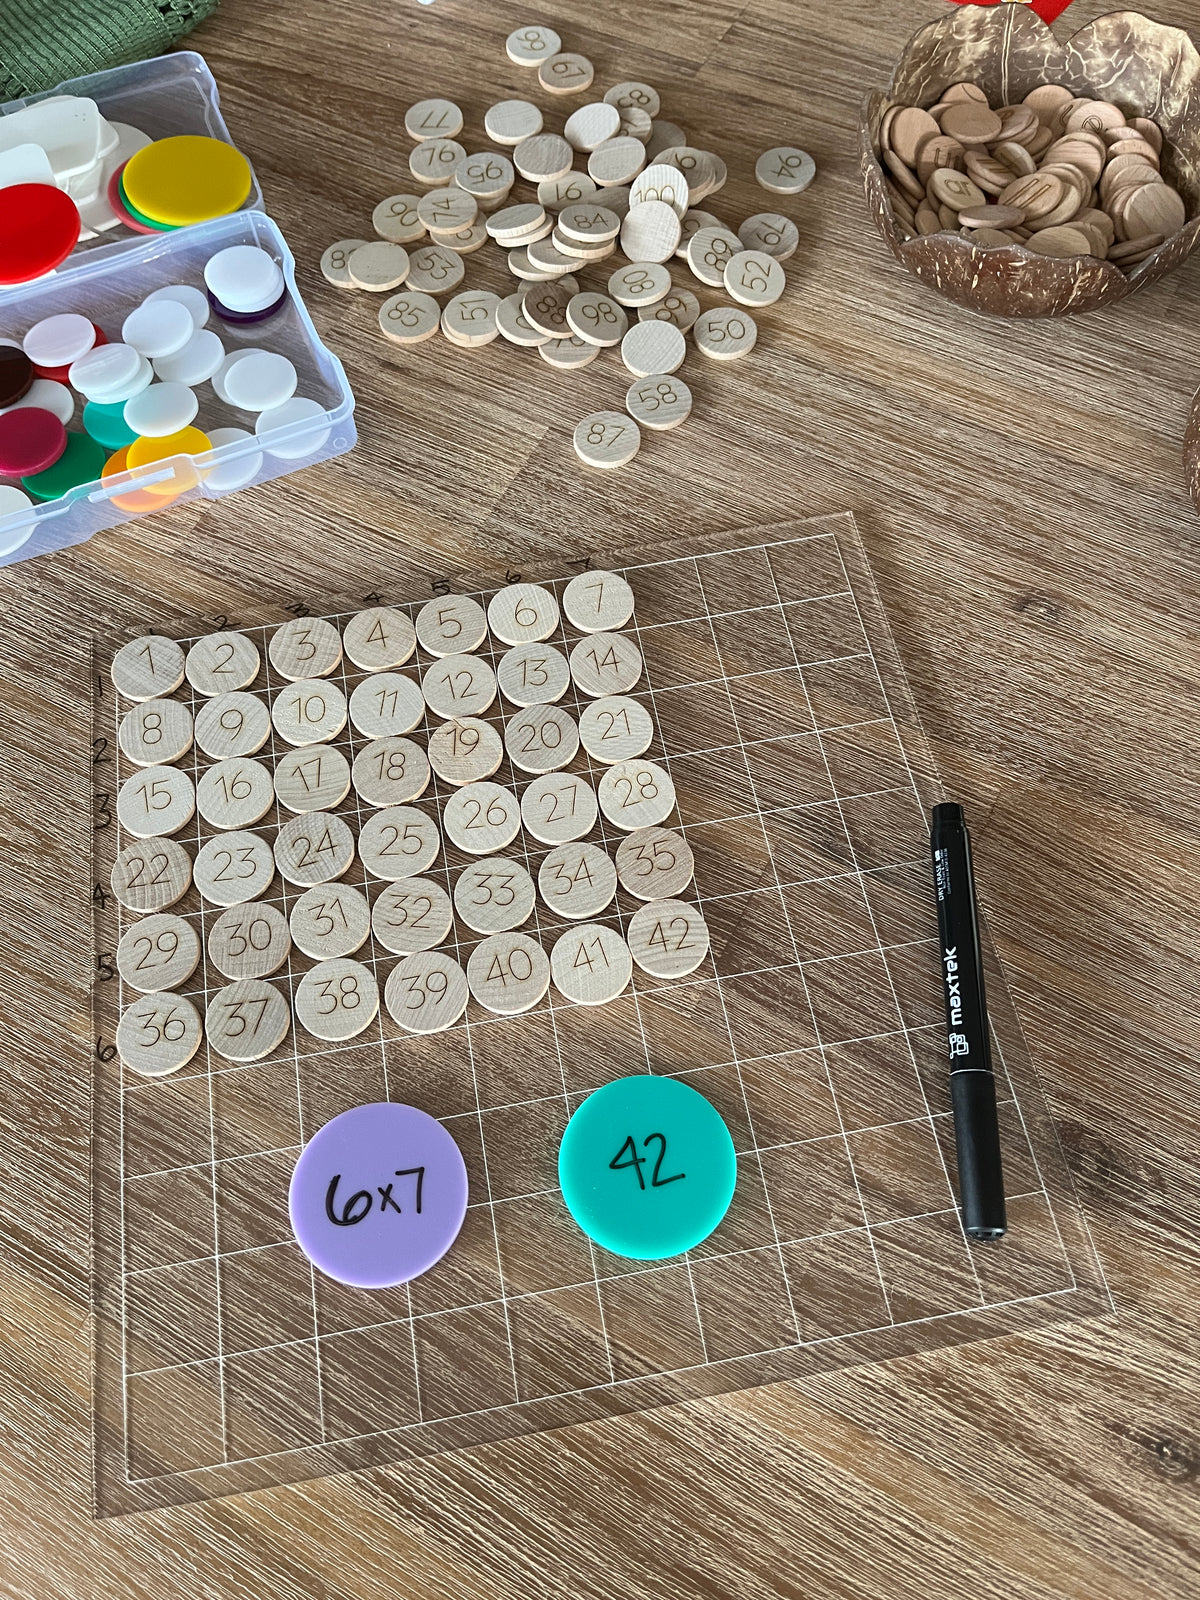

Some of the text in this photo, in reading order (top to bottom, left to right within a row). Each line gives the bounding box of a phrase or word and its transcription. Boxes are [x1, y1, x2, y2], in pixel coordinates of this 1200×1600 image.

[419, 111, 450, 129] 77
[421, 145, 456, 167] 76
[432, 198, 460, 223] 74
[574, 213, 609, 230] 84
[417, 252, 456, 280] 53
[741, 260, 771, 293] 52
[388, 301, 426, 327] 85
[459, 299, 488, 321] 51
[582, 302, 617, 327] 98
[708, 319, 745, 342] 50
[638, 383, 677, 411] 58
[587, 422, 625, 448] 87
[430, 579, 450, 597] 5
[505, 569, 522, 584] 6
[514, 598, 538, 627] 6
[585, 583, 604, 613] 7
[366, 619, 389, 648] 4
[438, 608, 462, 639] 5
[139, 644, 155, 675] 1
[211, 643, 236, 674] 2
[292, 630, 317, 661] 3
[586, 646, 621, 675] 14
[441, 671, 479, 700] 12
[516, 659, 548, 687] 13
[290, 695, 326, 724] 10
[375, 690, 399, 717] 11
[142, 713, 163, 745] 8
[220, 709, 244, 741] 9
[517, 721, 562, 753] 20
[596, 708, 632, 740] 21
[92, 737, 111, 765] 2
[446, 727, 480, 756] 19
[291, 757, 322, 792] 17
[373, 751, 406, 781] 18
[135, 780, 172, 814] 15
[214, 770, 252, 803] 16
[614, 771, 659, 808] 28
[94, 793, 112, 831] 3
[462, 797, 507, 830] 26
[539, 785, 577, 823] 27
[291, 828, 338, 868] 24
[378, 824, 424, 857] 25
[126, 854, 171, 889] 22
[212, 847, 257, 882] 23
[629, 839, 676, 876] 35
[471, 872, 516, 906] 33
[548, 857, 595, 895] 34
[93, 882, 110, 910] 4
[387, 893, 432, 929] 32
[308, 898, 348, 937] 31
[224, 918, 272, 957] 30
[649, 917, 696, 952] 42
[133, 931, 179, 971] 29
[573, 936, 610, 974] 41
[96, 953, 114, 982] 5
[486, 948, 533, 987] 40
[314, 976, 361, 1015] 38
[402, 971, 448, 1010] 39
[943, 946, 963, 1026] maxtek
[137, 1007, 186, 1048] 36
[224, 998, 269, 1037] 37
[96, 1035, 117, 1063] 6
[609, 1132, 687, 1191] 42
[325, 1167, 425, 1227] 6x7
